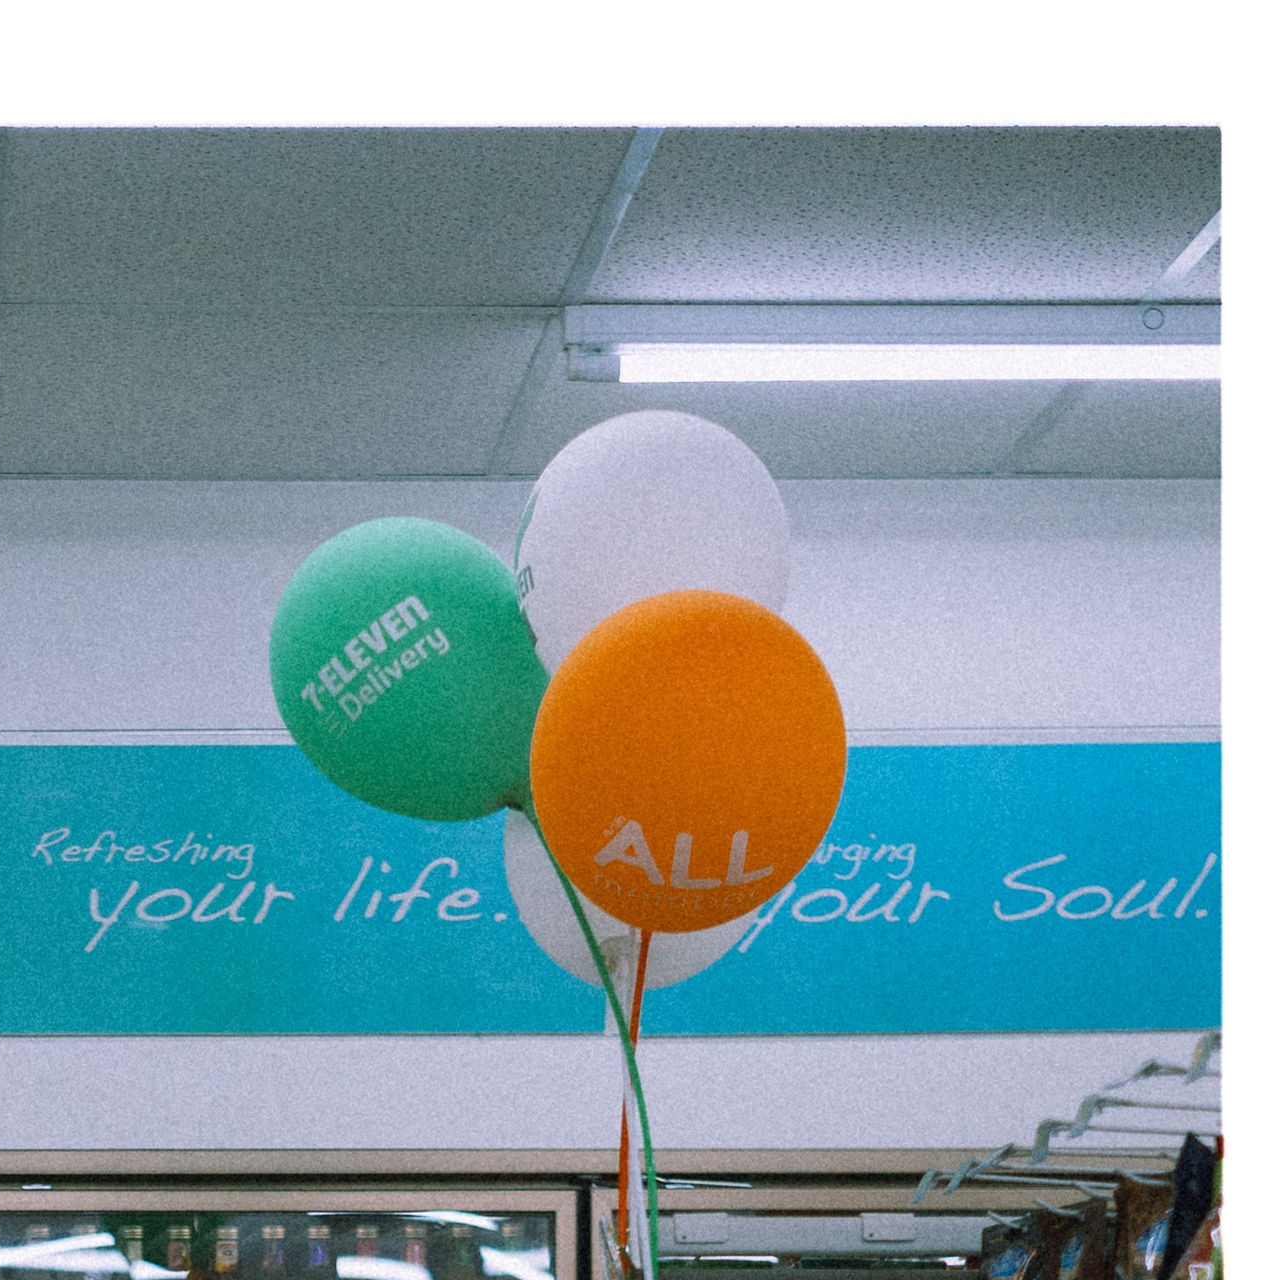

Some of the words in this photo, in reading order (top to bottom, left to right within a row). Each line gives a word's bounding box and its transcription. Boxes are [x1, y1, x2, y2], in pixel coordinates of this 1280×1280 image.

[337, 627, 451, 722] Delivery
[30, 827, 256, 878] Refreshing
[593, 819, 774, 889] ALL
[84, 880, 295, 953] your
[736, 881, 951, 953] your
[992, 854, 1209, 922] Soul.
